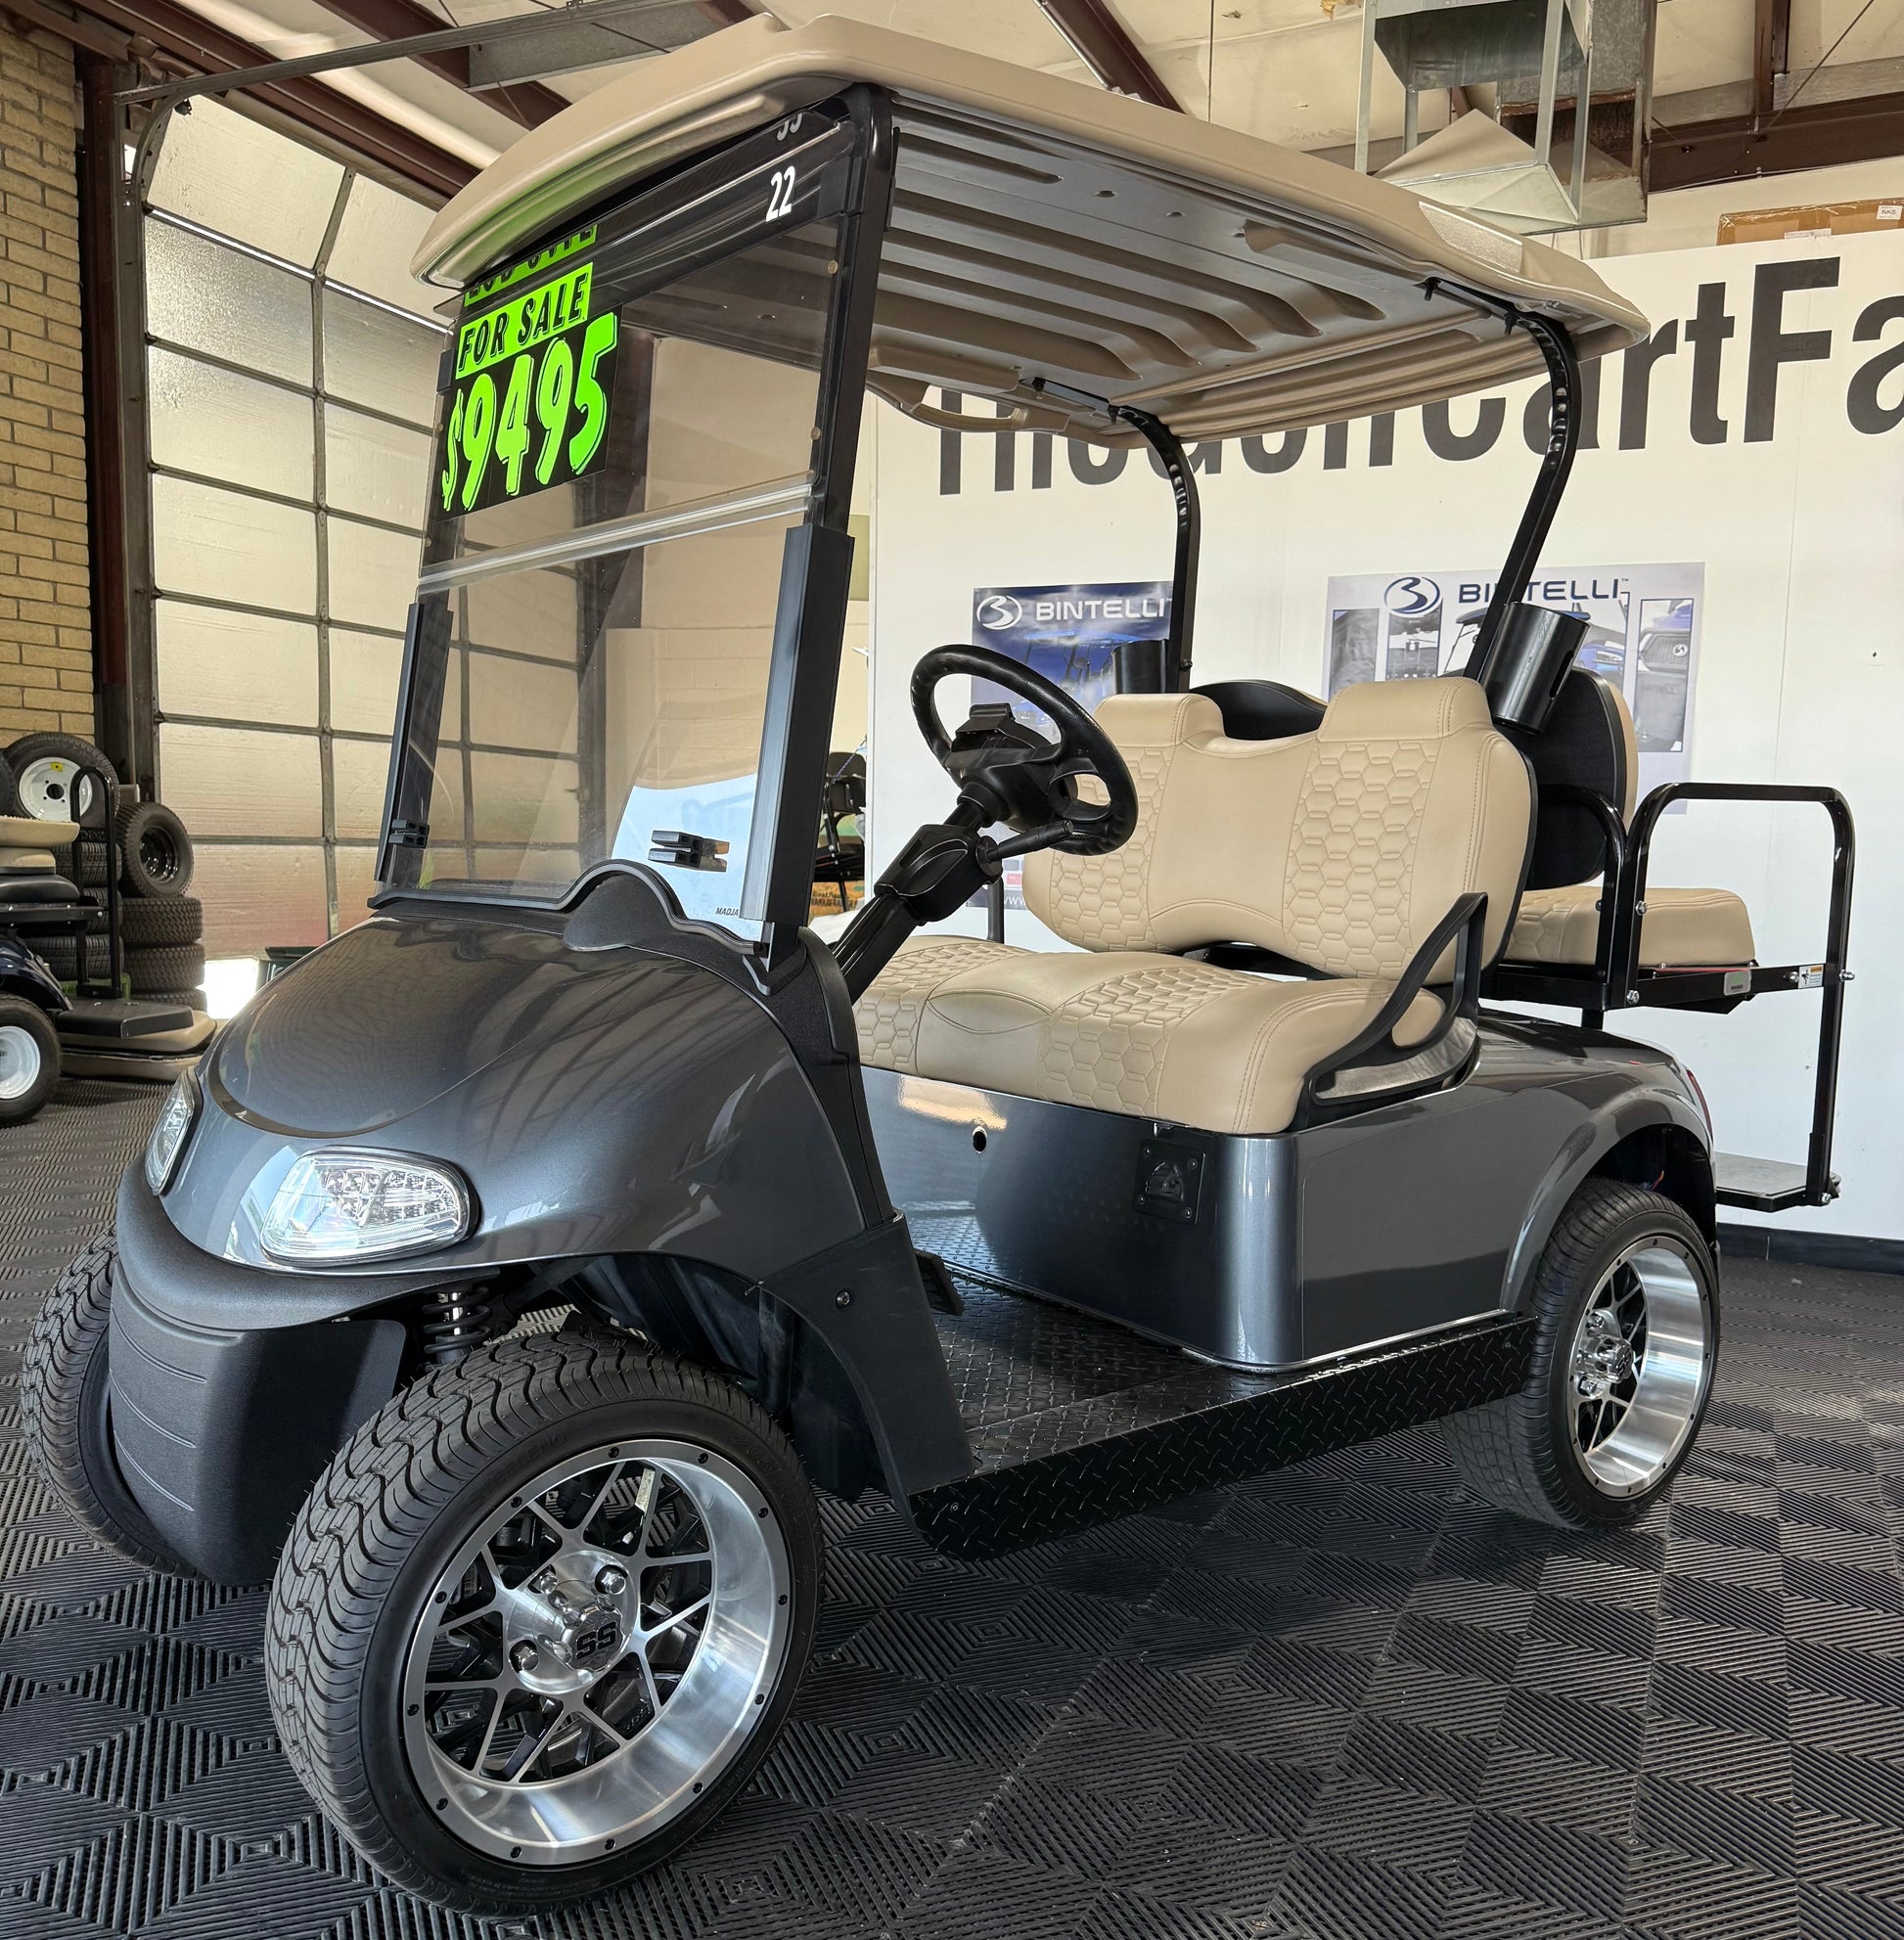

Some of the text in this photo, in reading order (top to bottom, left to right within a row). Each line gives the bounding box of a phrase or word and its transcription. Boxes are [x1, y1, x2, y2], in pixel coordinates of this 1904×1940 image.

[765, 165, 796, 223] 22
[458, 311, 509, 373] FOR
[518, 272, 590, 347] SALE
[441, 312, 618, 512] $9495
[1035, 599, 1165, 622] BINTELLI
[1457, 578, 1620, 605] BITELLI
[575, 1621, 617, 1660] SS
